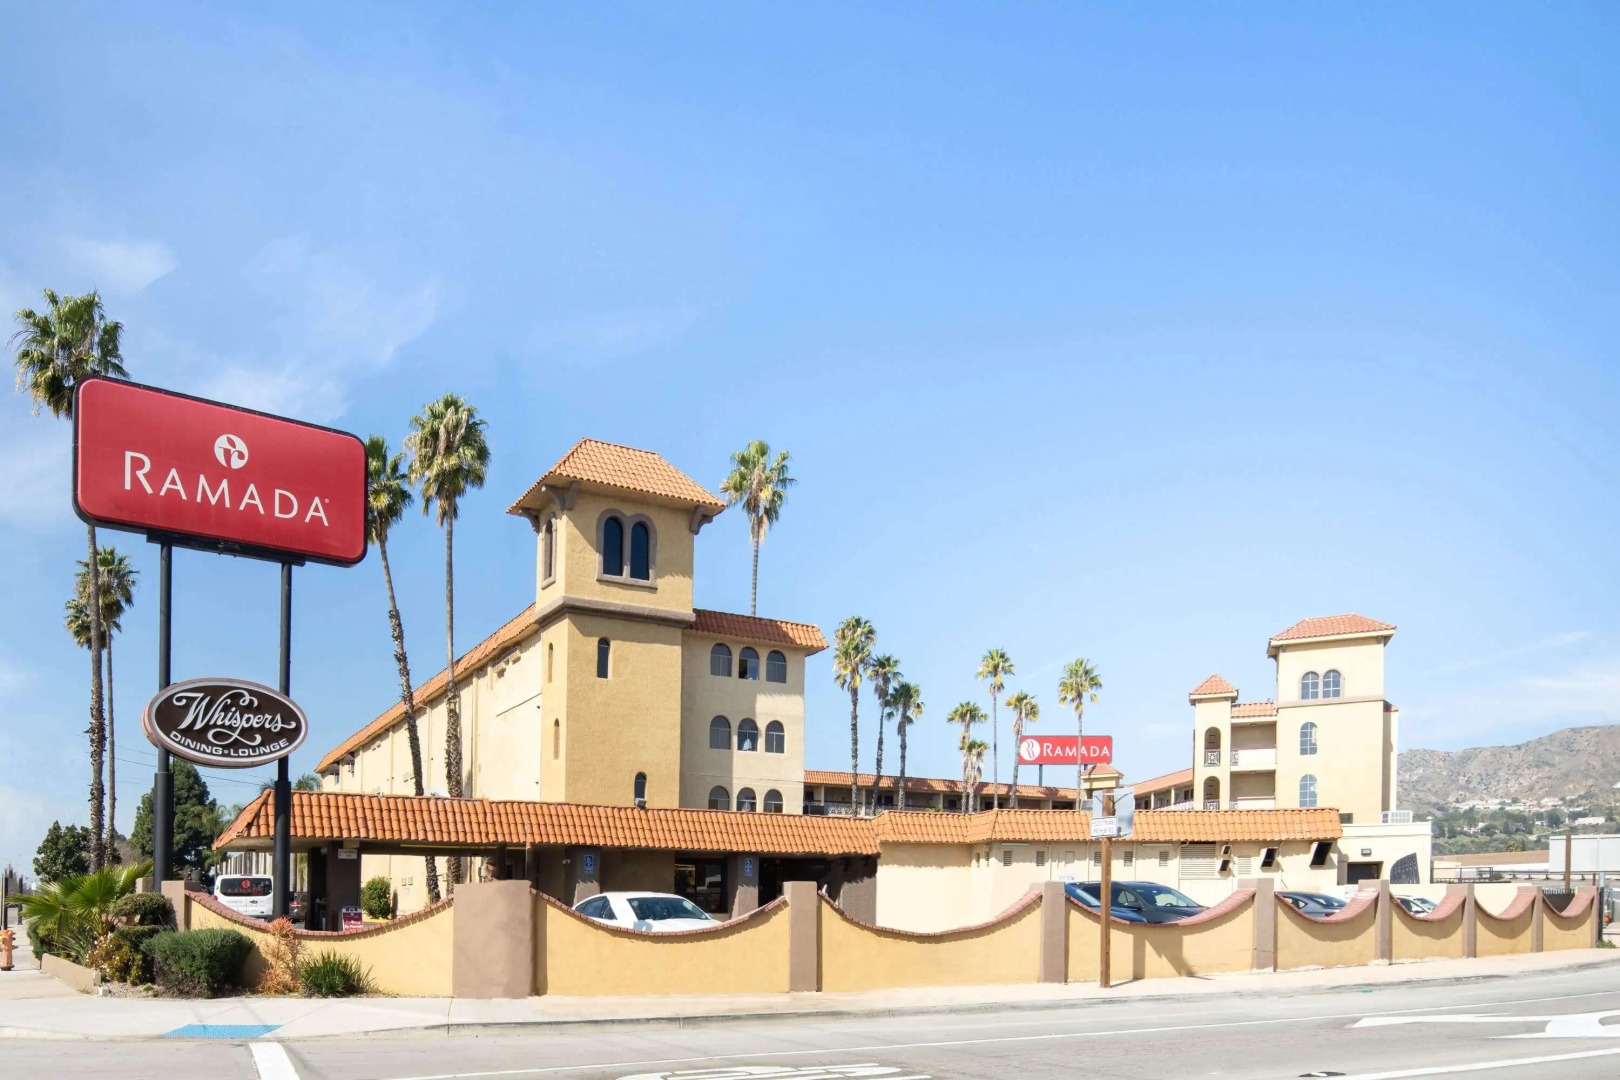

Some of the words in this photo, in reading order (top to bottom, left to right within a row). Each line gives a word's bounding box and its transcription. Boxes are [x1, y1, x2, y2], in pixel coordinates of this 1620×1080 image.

[124, 451, 328, 527] RAMADA
[173, 689, 296, 746] Whispers
[170, 730, 223, 755] DINING
[230, 738, 289, 757] LOUNGE
[1043, 743, 1110, 757] RAMADA
